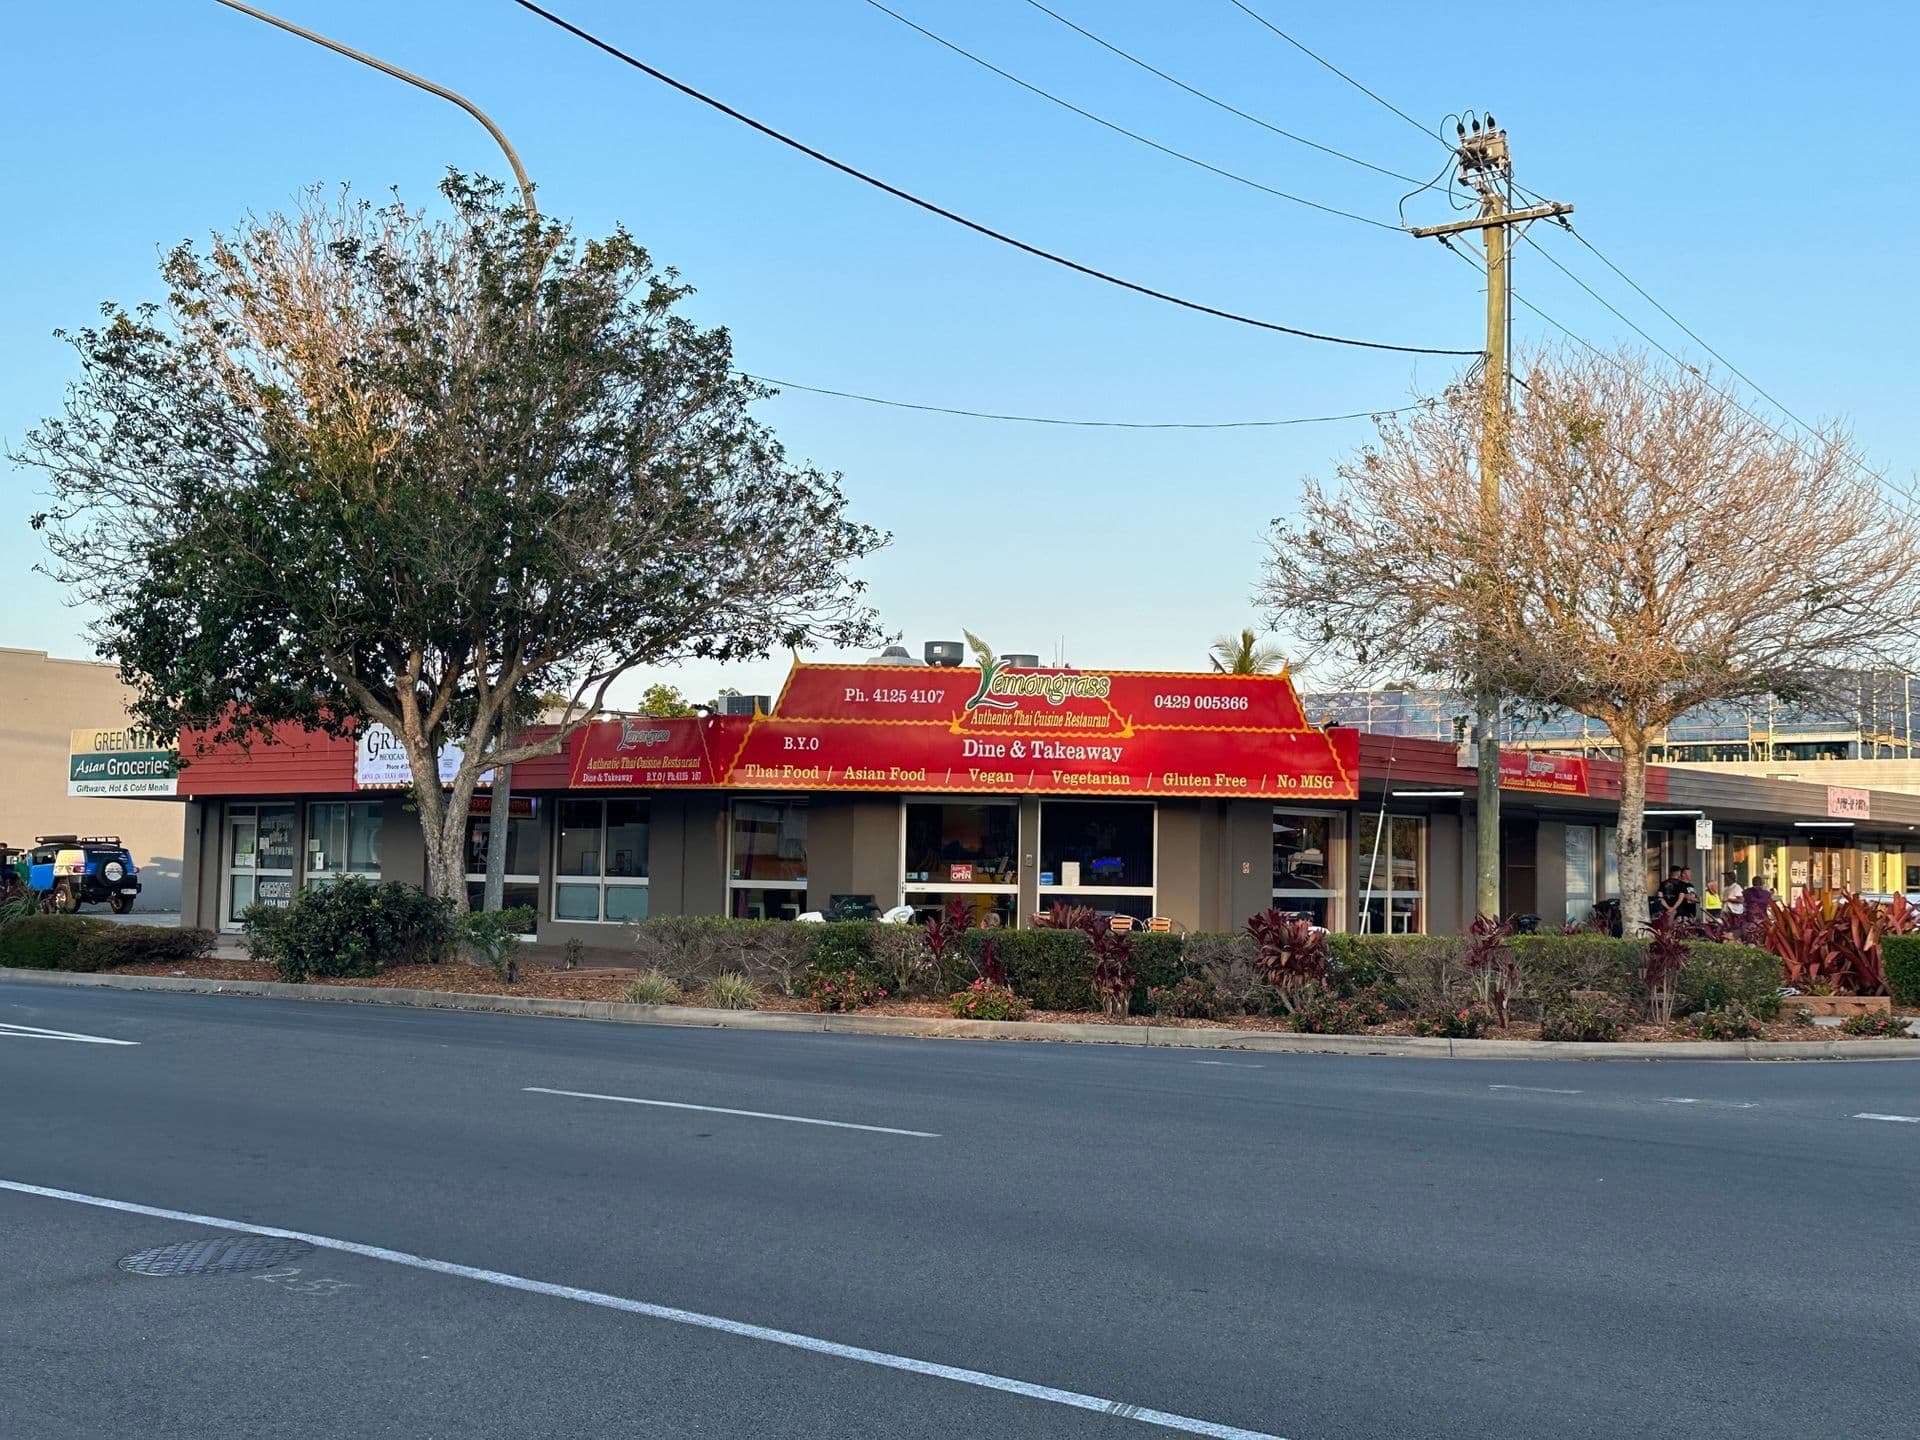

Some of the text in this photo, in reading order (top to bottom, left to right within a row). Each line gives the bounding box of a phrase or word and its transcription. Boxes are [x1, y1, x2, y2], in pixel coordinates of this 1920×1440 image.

[965, 659, 1112, 712] Lemongrass
[845, 688, 945, 704] Ph. 4125 4107
[1154, 695, 1249, 711] 0429 005366
[971, 710, 1110, 728] Authentic Thai Cuisine Restaurant
[94, 731, 129, 751] GREEN
[784, 737, 819, 750] B.Y.O
[962, 739, 1123, 762] Dine & Takeaway
[107, 757, 169, 775] Groceries
[745, 764, 779, 778] Thai
[783, 765, 819, 779] Food
[843, 766, 886, 781] Asian
[890, 767, 926, 781] Food
[969, 769, 1014, 784] Vegan
[1052, 770, 1130, 786] Vegetarian
[1163, 773, 1211, 787] Gluten
[1214, 774, 1248, 788] Free
[1277, 776, 1297, 788] No
[1300, 776, 1334, 789] MSG
[76, 785, 106, 793] Giftware,
[109, 784, 121, 793] Hot
[130, 784, 146, 792] Cold
